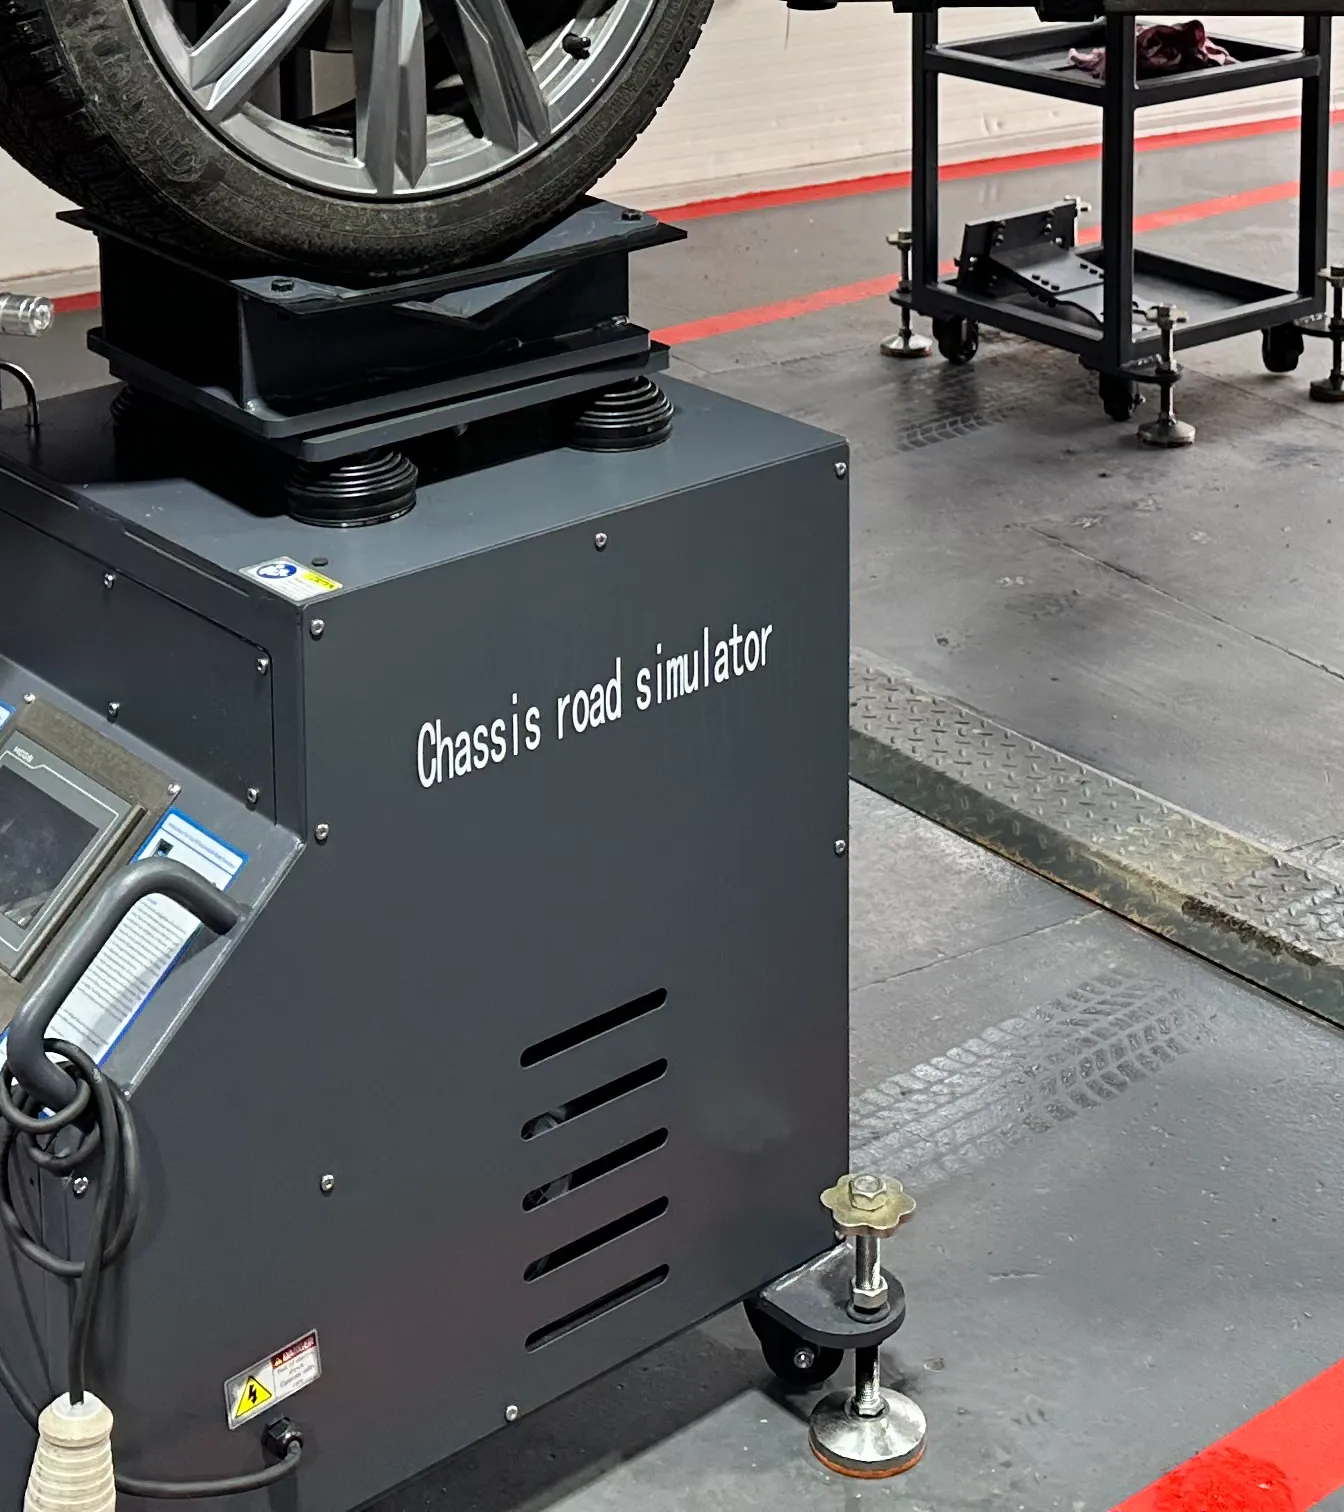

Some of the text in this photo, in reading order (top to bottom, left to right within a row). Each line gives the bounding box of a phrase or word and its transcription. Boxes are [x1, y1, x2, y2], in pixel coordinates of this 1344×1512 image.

[417, 623, 772, 788] Chassis road simulator
